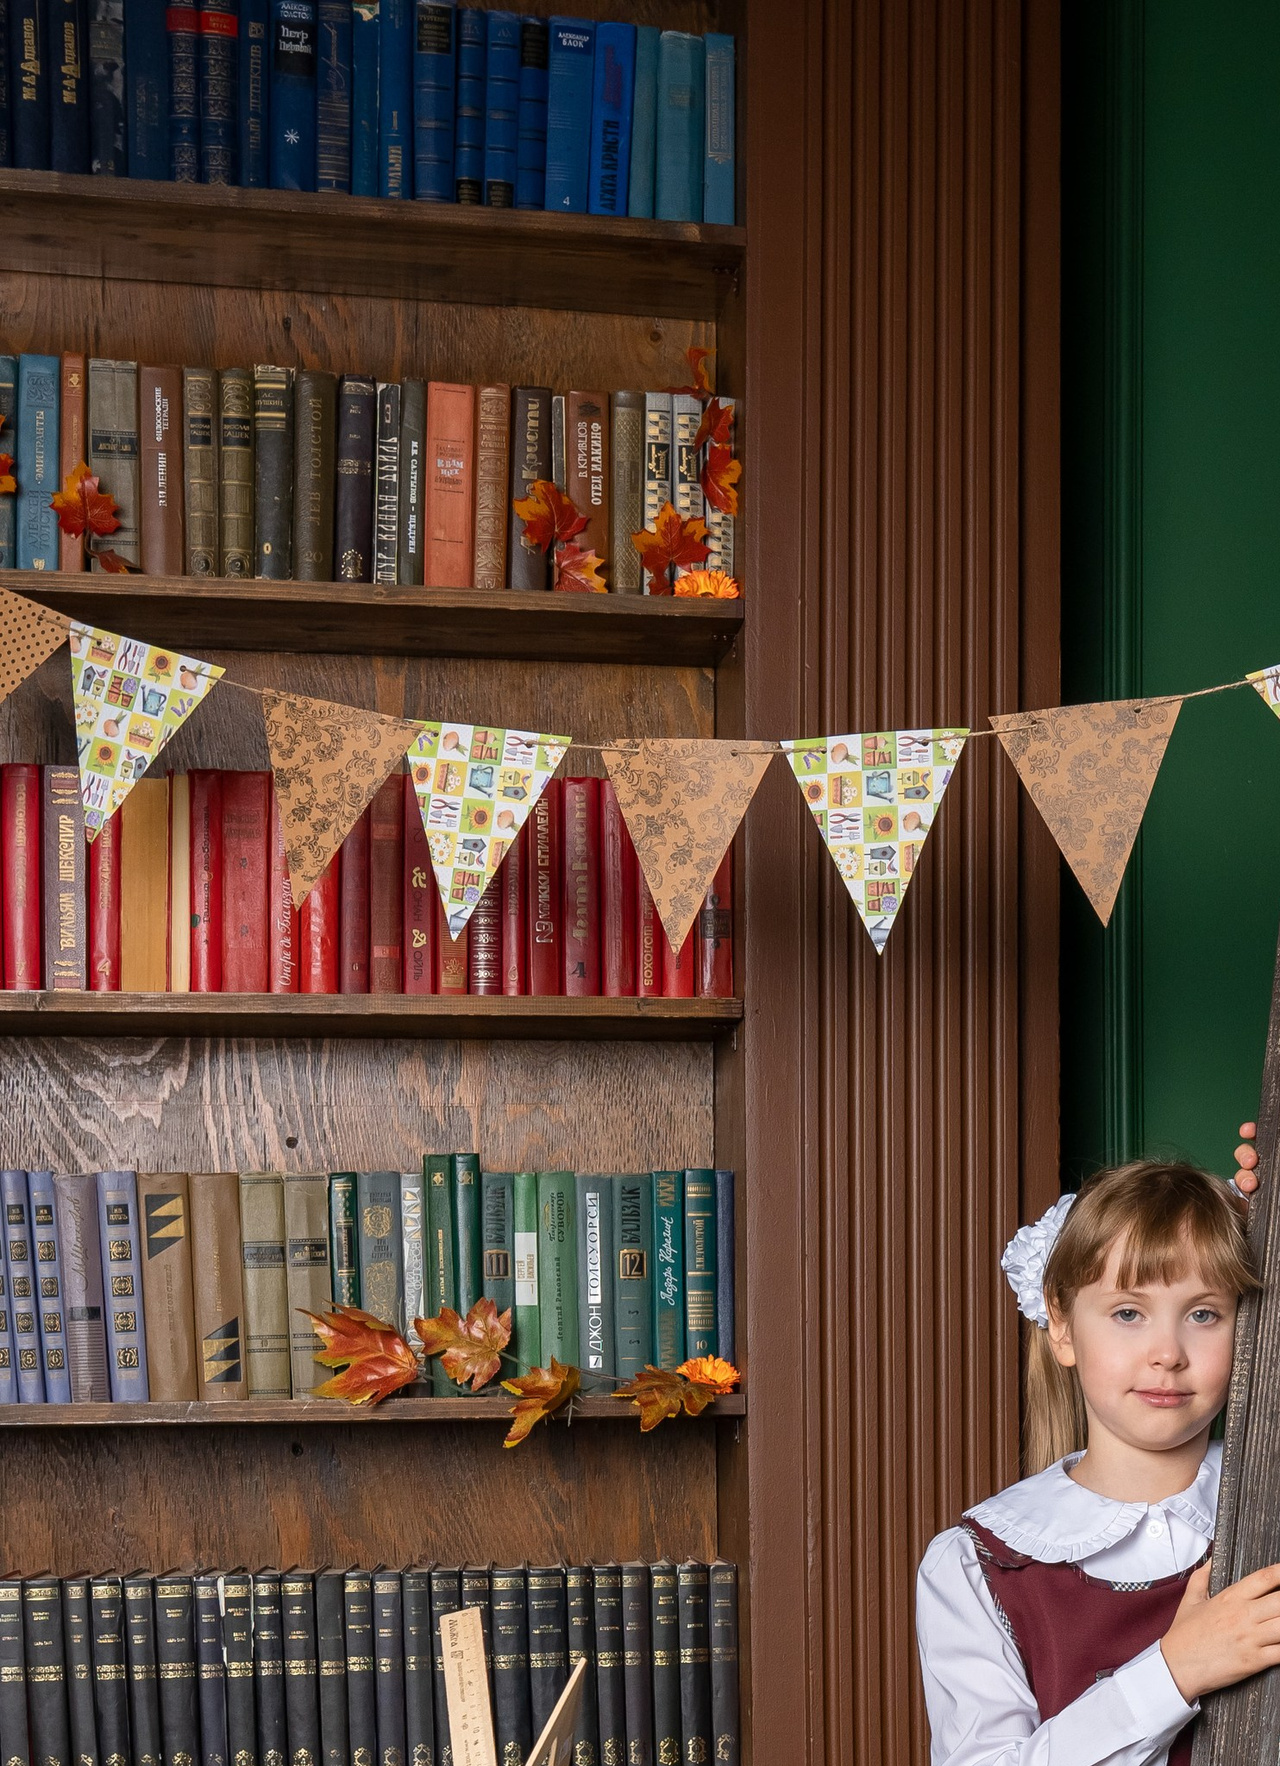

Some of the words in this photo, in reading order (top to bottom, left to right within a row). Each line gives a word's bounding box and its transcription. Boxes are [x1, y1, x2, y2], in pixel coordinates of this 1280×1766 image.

[562, 39, 585, 49] БЛОК
[602, 119, 620, 171] КРИСТИ
[600, 173, 617, 212] АГАТА
[309, 397, 323, 481] ТОЛСТОЙ
[590, 422, 602, 470] ИАКИНФ
[309, 490, 322, 526] ЛЕВ
[590, 471, 602, 506] ОТЕЦ
[408, 514, 417, 554] ЩЕДРИН
[58, 814, 76, 883] ШЕКСПИР
[537, 797, 550, 868] СПИЛЛЕЙН
[538, 869, 551, 920] МИККИ
[59, 892, 76, 951] ВИЛЬЯМ
[282, 938, 292, 950] де
[642, 924, 654, 987] ШОЛОХОВ
[556, 1191, 565, 1243] СУВОРОВ
[621, 1185, 641, 1244] БАЛЬЗАК
[587, 1194, 600, 1297] ГОЛСУОРСИ
[624, 1254, 642, 1275] 12
[588, 1305, 603, 1353] ДЖОН
[52, 1353, 59, 1363] 6
